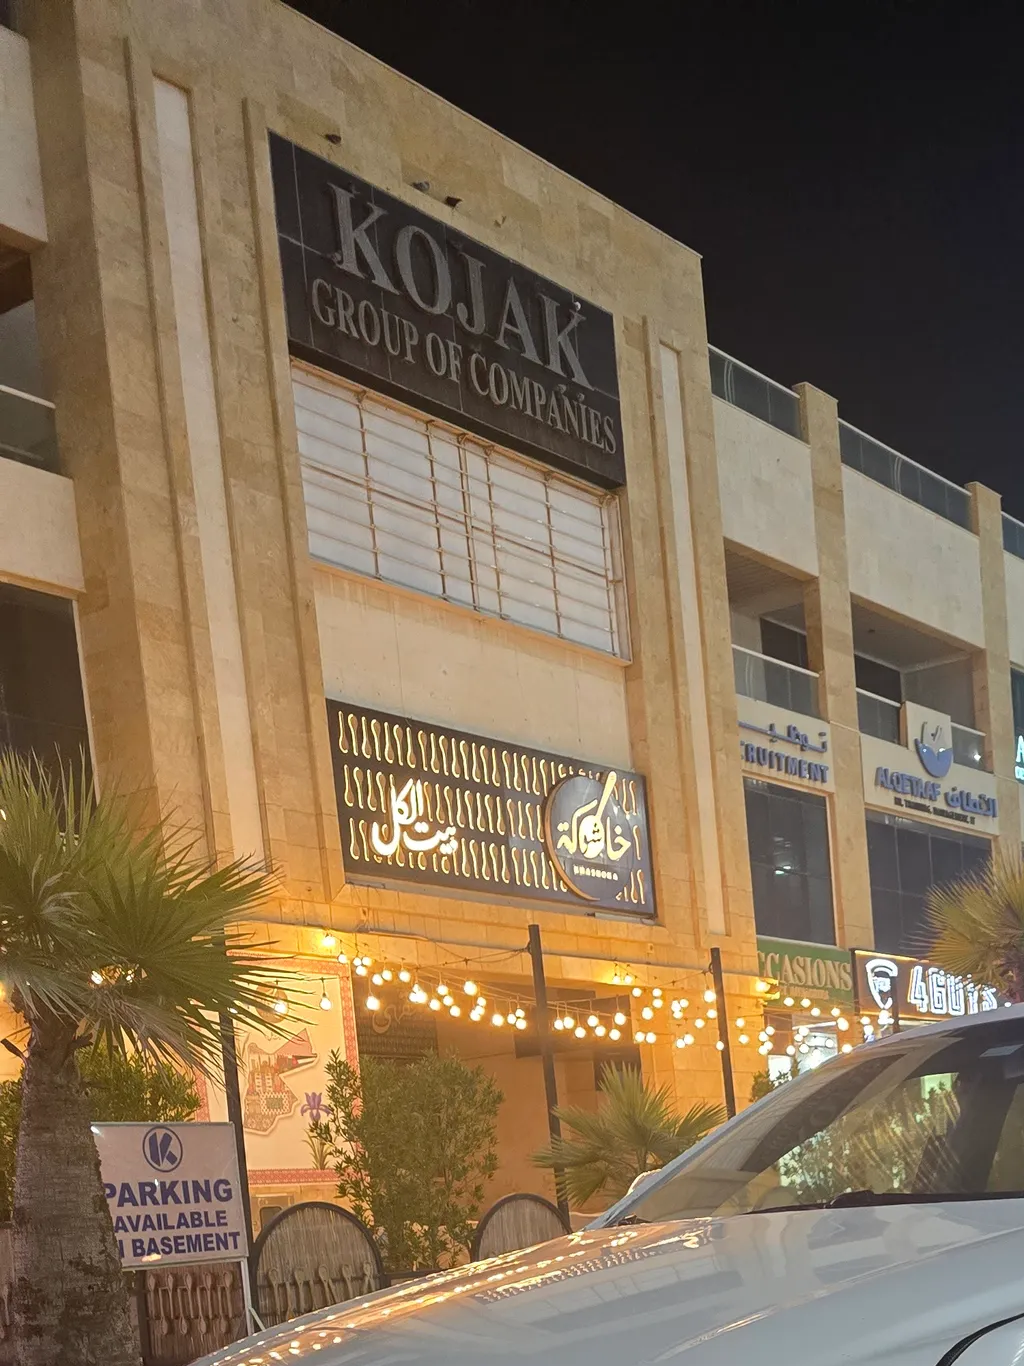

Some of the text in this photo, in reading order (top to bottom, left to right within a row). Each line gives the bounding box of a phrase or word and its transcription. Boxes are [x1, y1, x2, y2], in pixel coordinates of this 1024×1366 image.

[327, 182, 594, 391] KOJAK
[311, 278, 617, 455] GROUP OF COMPANIES
[740, 740, 829, 783] RUITMENT
[103, 1179, 233, 1207] PARKING
[114, 1210, 228, 1233] AVAILABLE
[131, 1231, 240, 1258] BASEMENT
